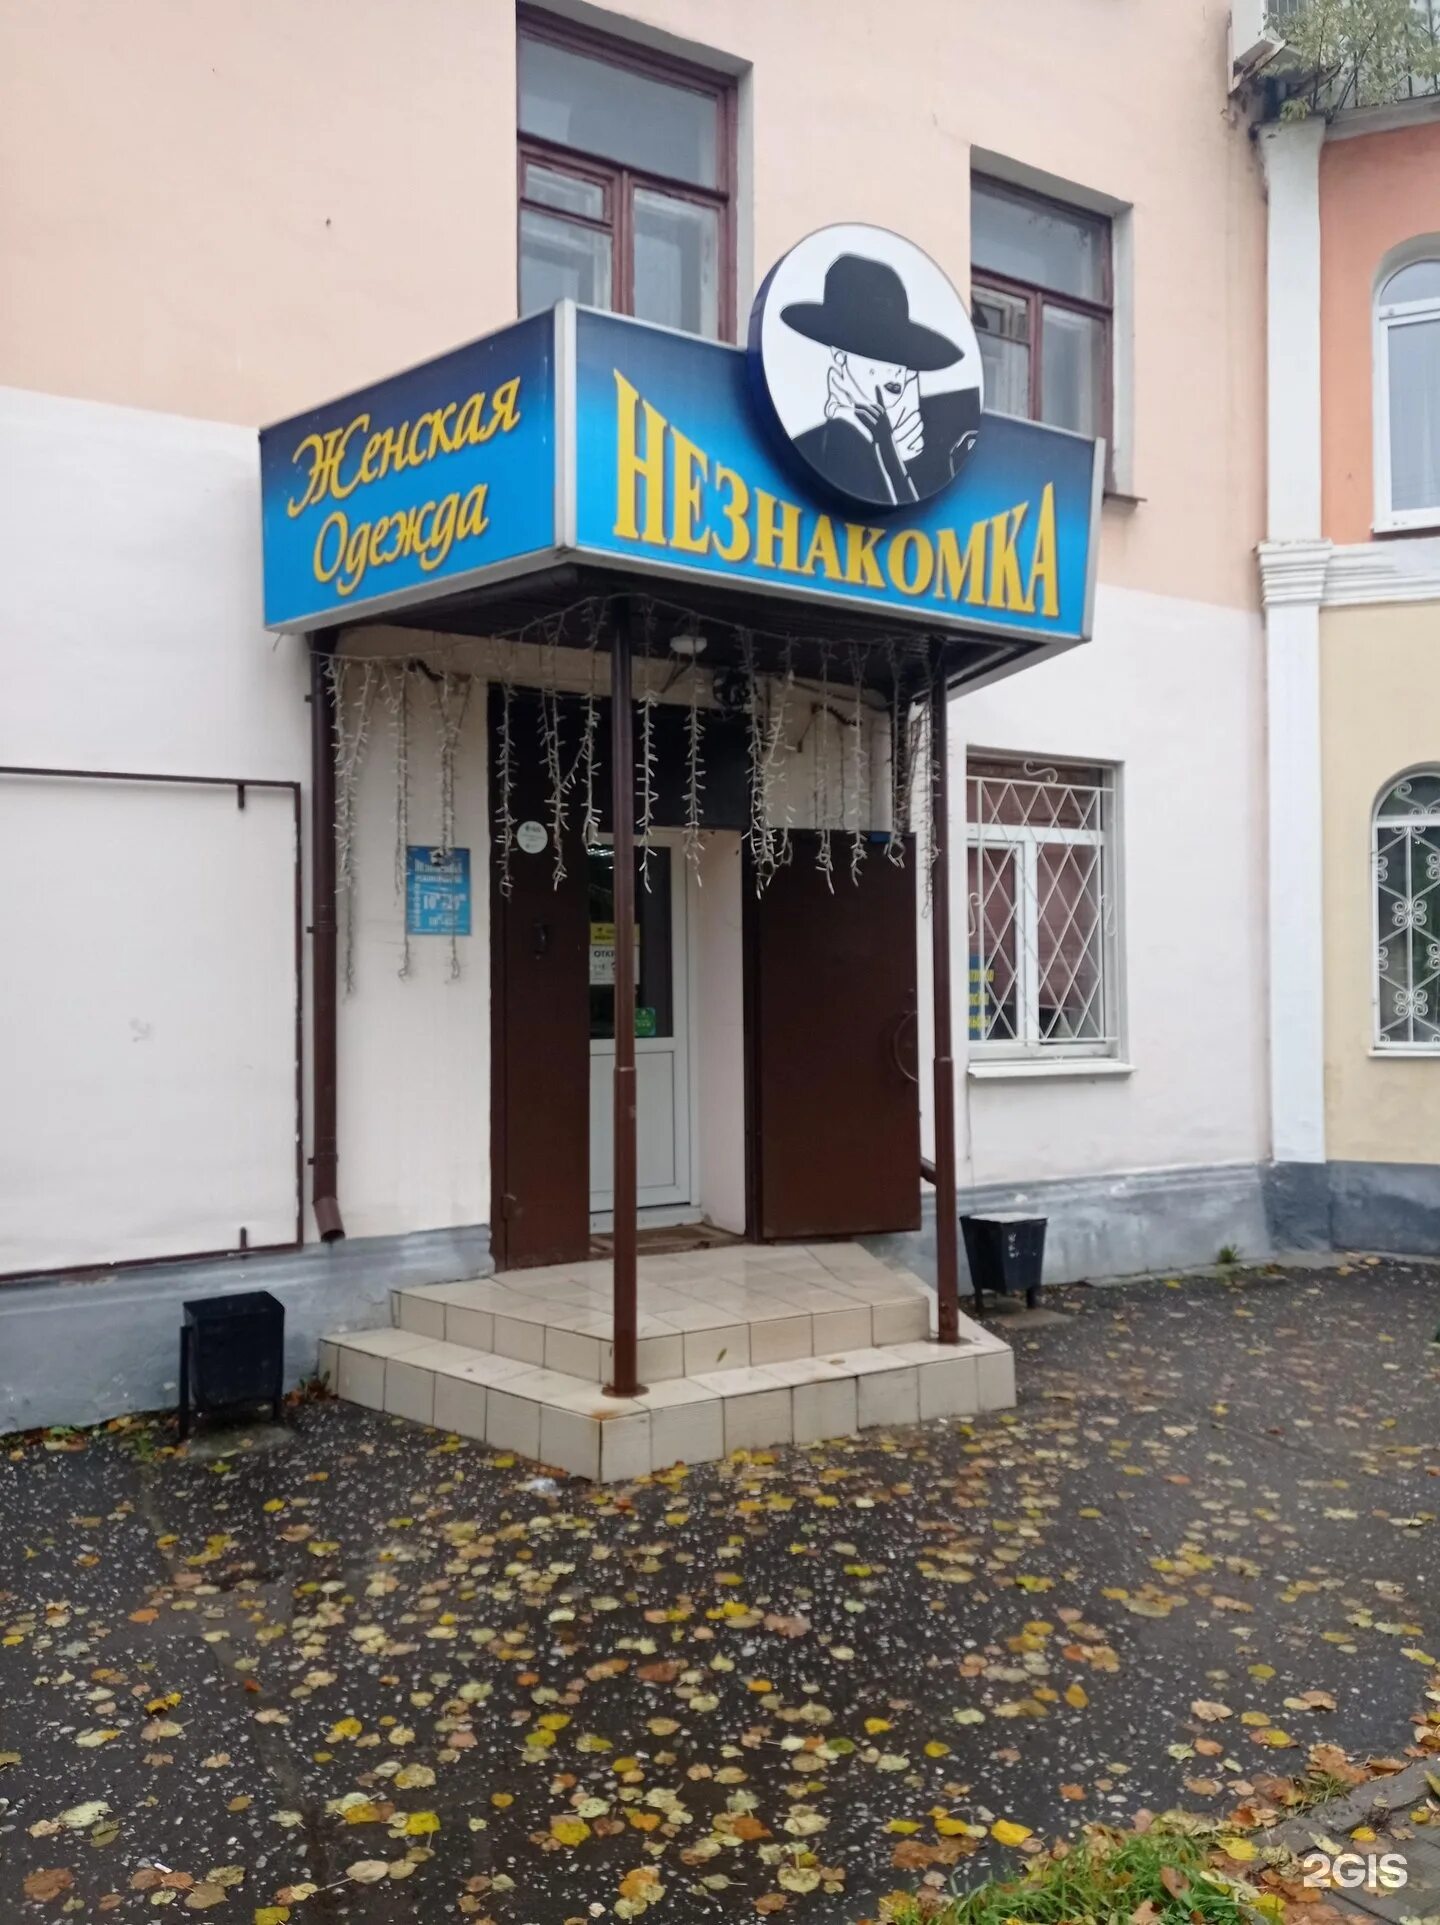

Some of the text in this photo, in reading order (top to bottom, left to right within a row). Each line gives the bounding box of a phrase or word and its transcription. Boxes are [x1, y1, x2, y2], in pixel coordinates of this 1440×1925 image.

[287, 376, 521, 518] Женская
[613, 368, 1060, 619] НЕЗНАКОМКА
[313, 483, 489, 596] Одежда
